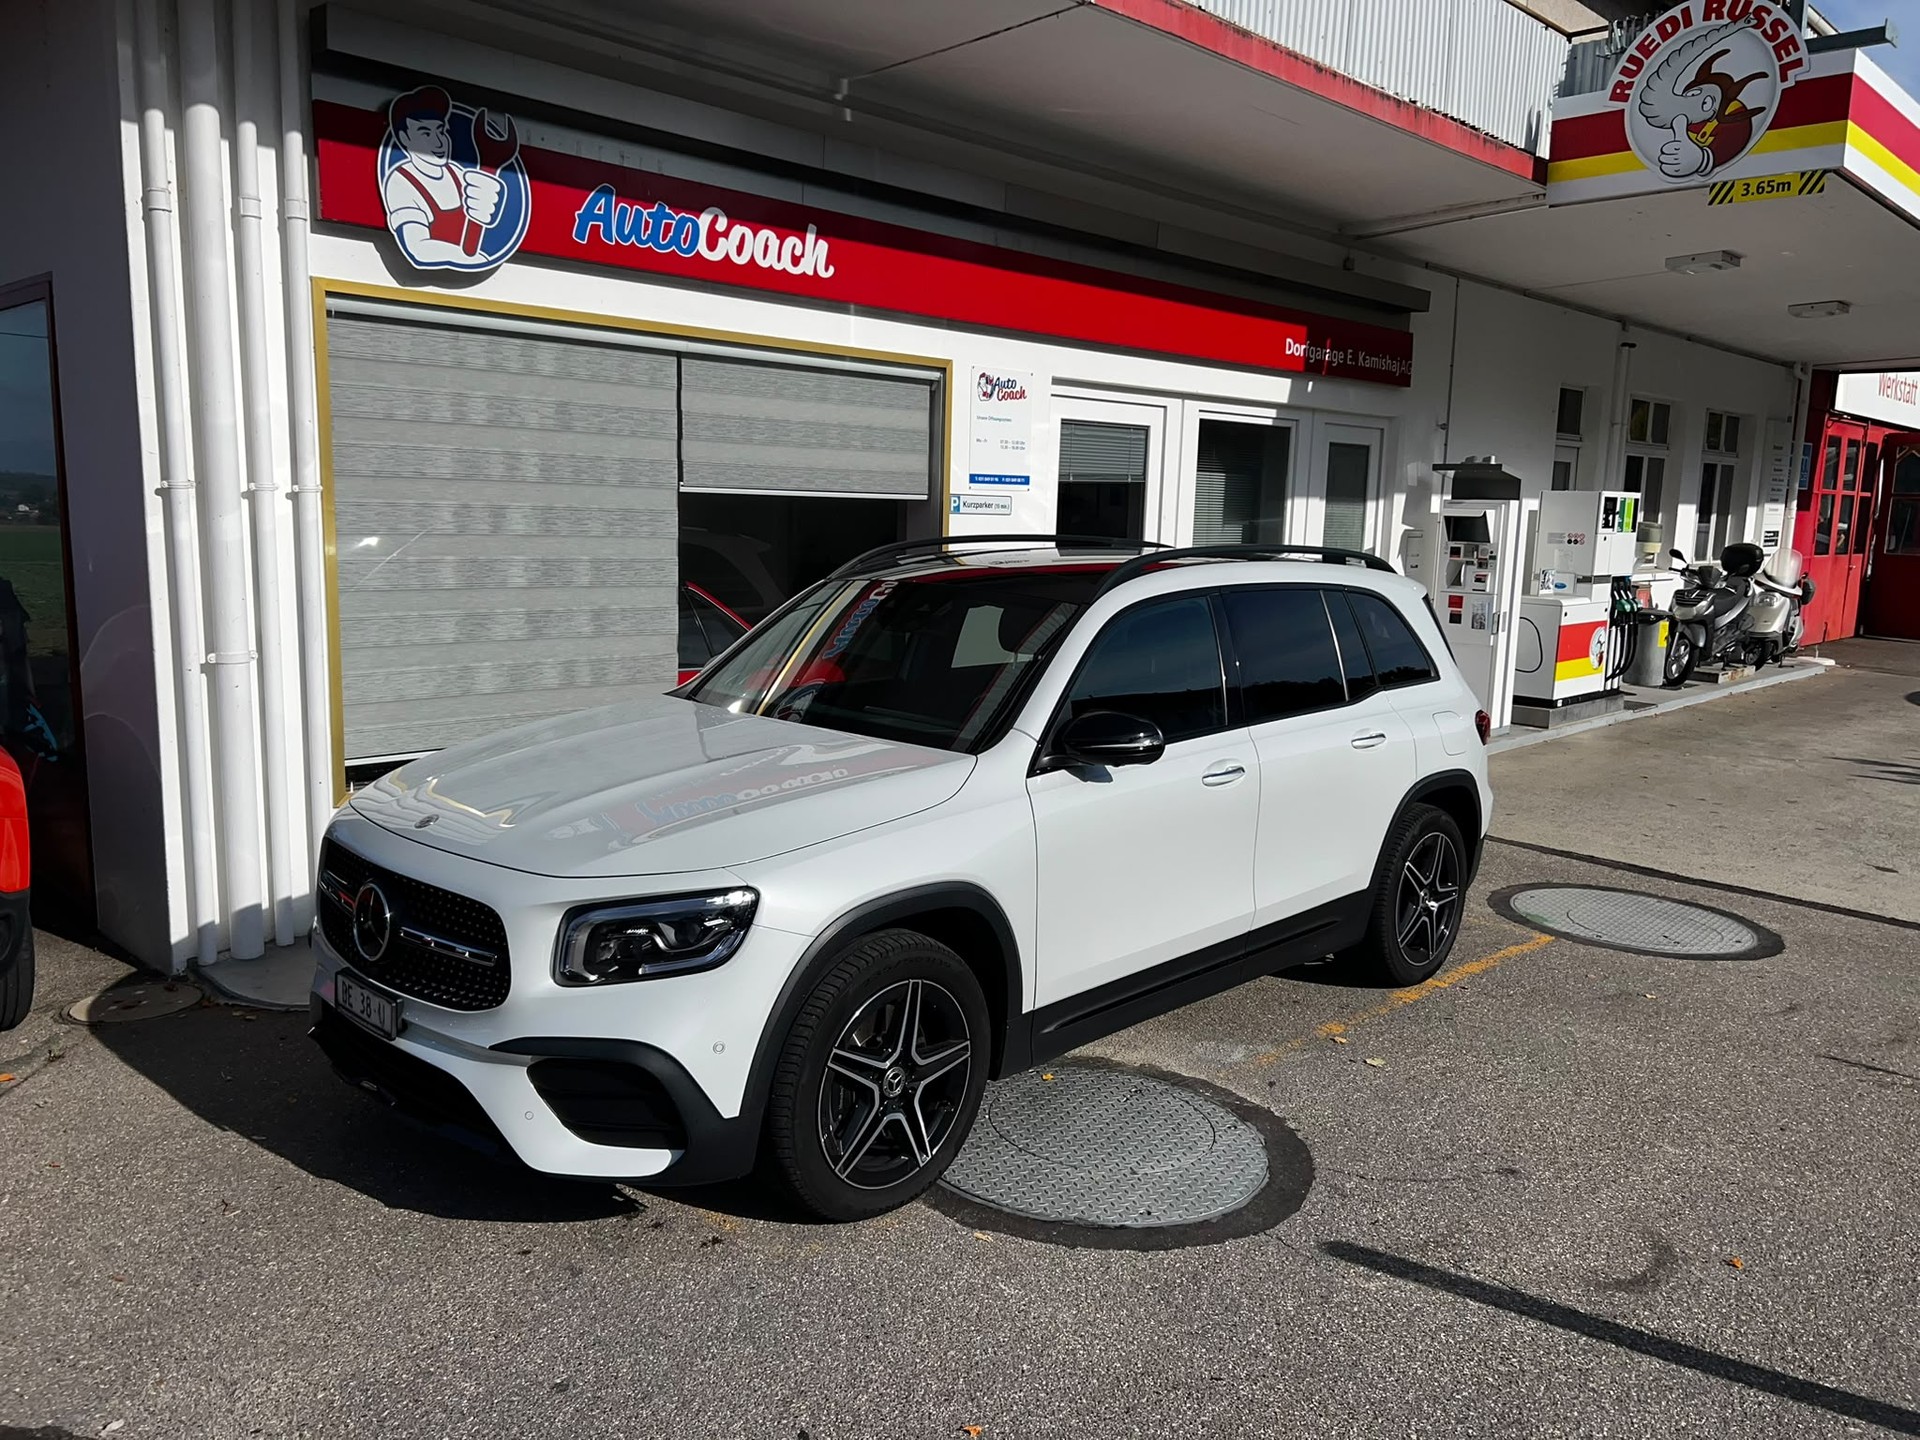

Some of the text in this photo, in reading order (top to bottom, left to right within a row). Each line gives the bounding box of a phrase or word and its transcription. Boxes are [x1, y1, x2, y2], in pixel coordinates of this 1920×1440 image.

[1609, 0, 1804, 103] RUEDI RUSSEL
[1740, 180, 1792, 197] 3.65m
[572, 183, 835, 278] AutoCoach
[1285, 337, 1344, 366] Dorfgarage
[1346, 349, 1356, 365] E.
[1358, 350, 1400, 376] Kamishaj
[993, 376, 1018, 390] Auto
[996, 387, 1028, 402] Coach
[1878, 373, 1918, 406] Werkstatt
[962, 500, 994, 510] Kurzparker
[342, 980, 353, 1009] BE
